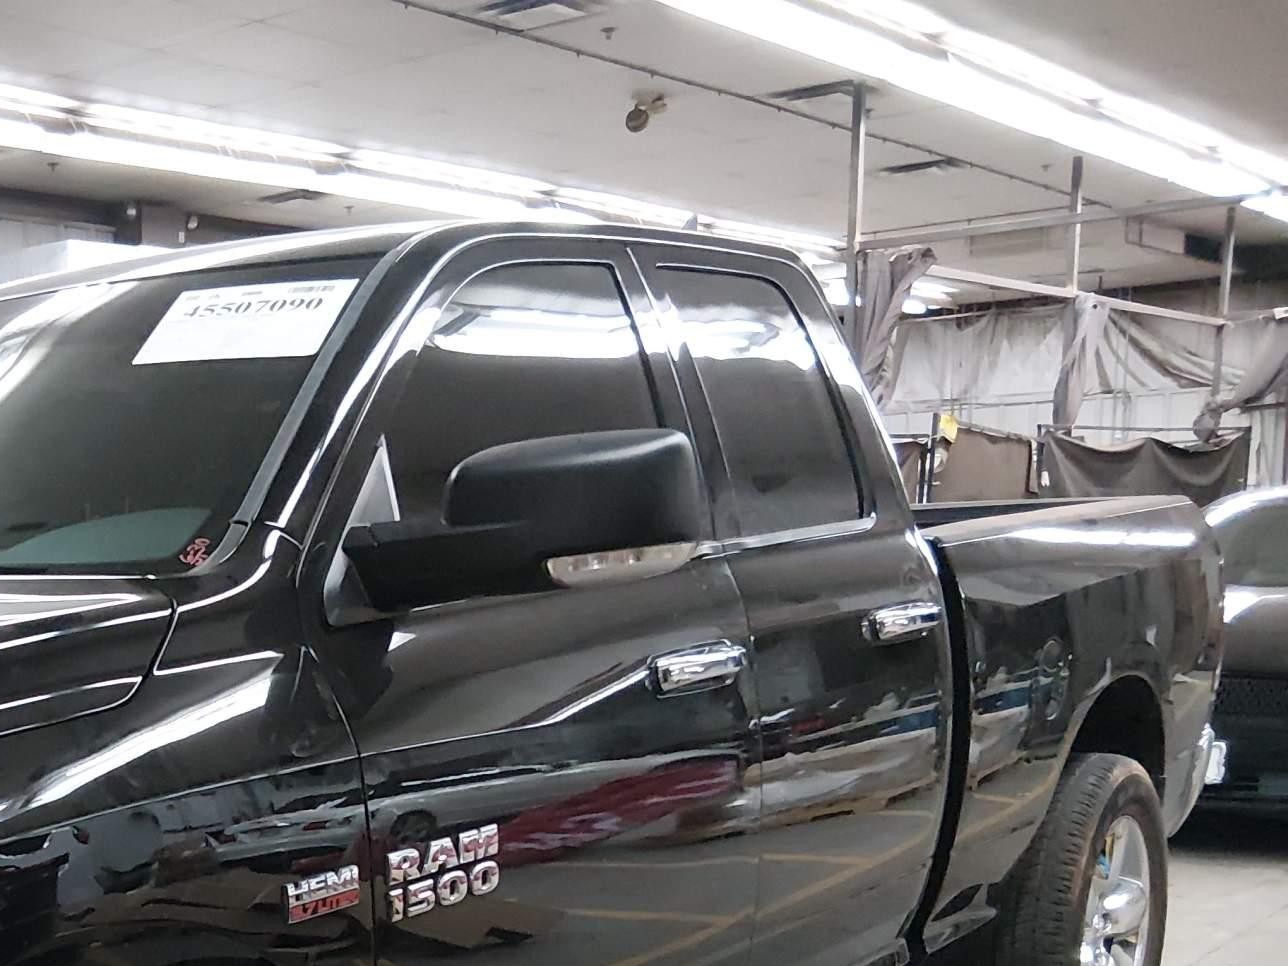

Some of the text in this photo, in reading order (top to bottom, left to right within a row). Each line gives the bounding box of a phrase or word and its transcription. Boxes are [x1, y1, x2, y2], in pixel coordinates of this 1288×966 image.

[184, 298, 324, 317] 45507090
[386, 823, 499, 886] RAM
[285, 864, 360, 906] HEMI
[388, 860, 500, 923] 1500
